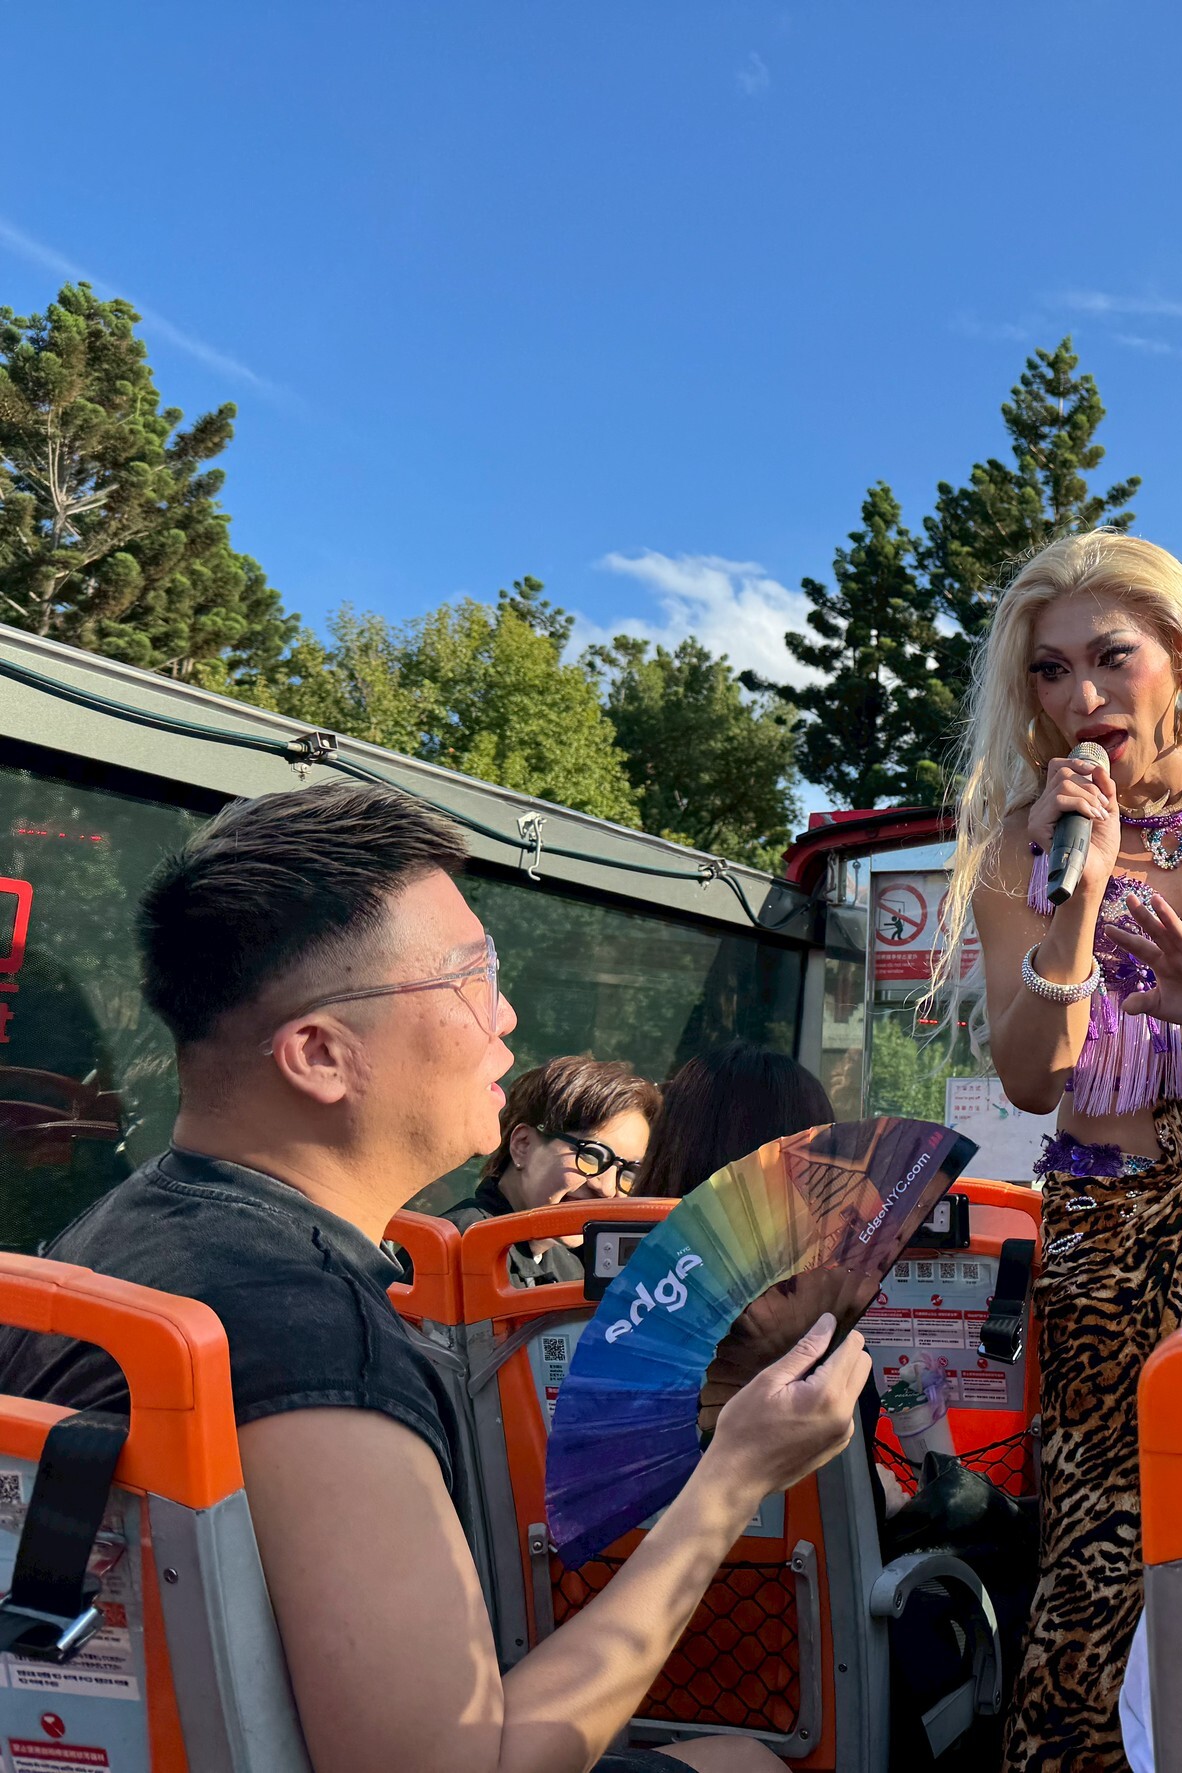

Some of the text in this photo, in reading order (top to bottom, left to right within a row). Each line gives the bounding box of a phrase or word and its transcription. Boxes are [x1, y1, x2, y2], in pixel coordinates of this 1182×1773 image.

[859, 1153, 931, 1244] EdgeNYC.com
[676, 1246, 692, 1256] NYC
[605, 1254, 704, 1344] edge
